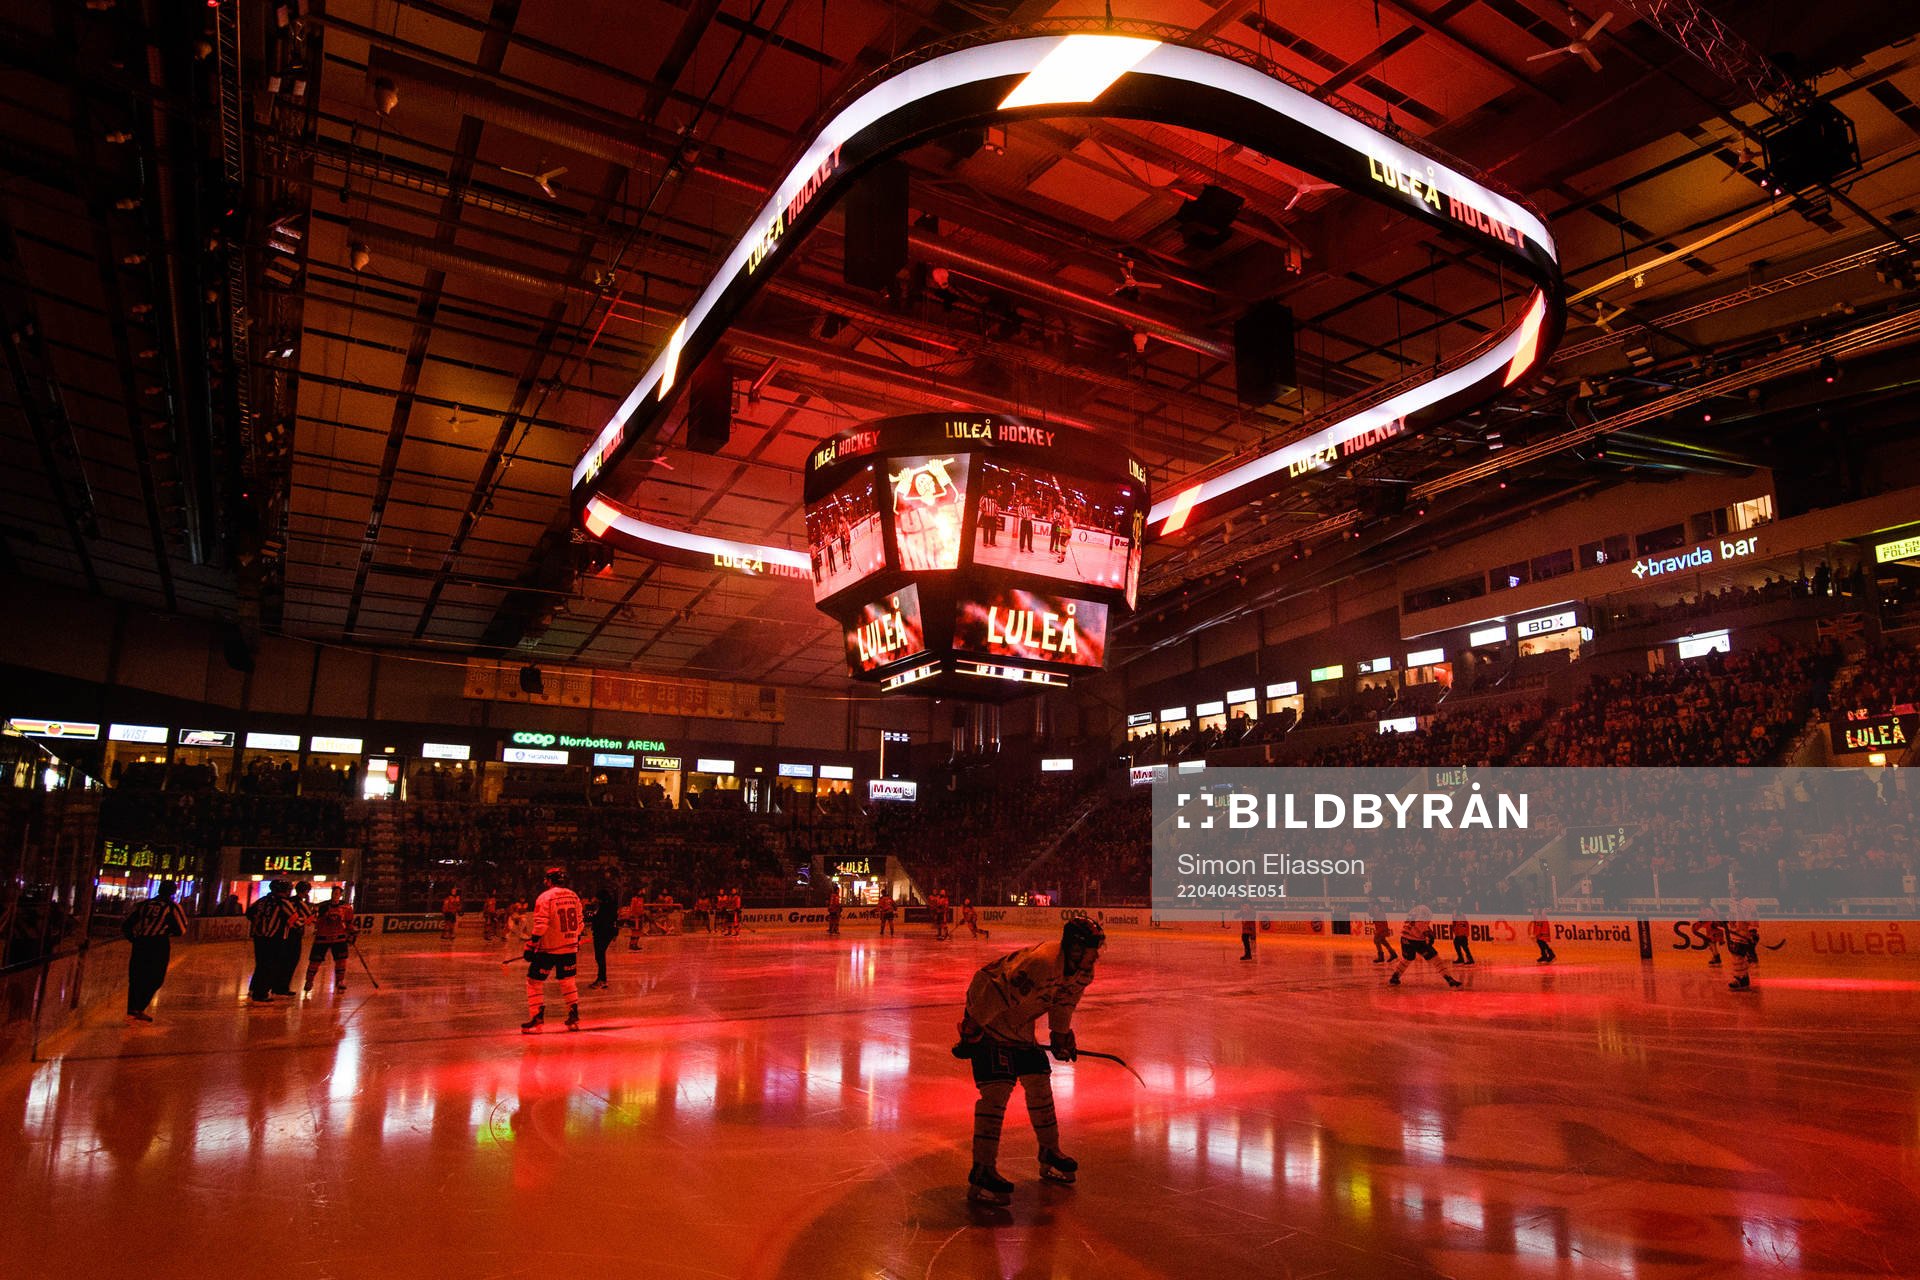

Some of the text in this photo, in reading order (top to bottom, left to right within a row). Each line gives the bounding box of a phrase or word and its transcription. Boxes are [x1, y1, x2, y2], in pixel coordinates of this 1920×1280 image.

[747, 144, 843, 276] LULEÅ HOCKEY
[1368, 152, 1527, 248] LULEÅ HOCKEY
[945, 419, 1055, 447] LULEÅ HOCKEY
[814, 430, 880, 471] LULEÅ HOCKEY
[1289, 415, 1408, 478] LULEÅ HOCKEY
[714, 549, 763, 573] LULEÅ
[1648, 536, 1758, 576] bravida bar
[857, 597, 907, 663] LULEÅ
[988, 603, 1078, 654] LULEÅ
[1528, 617, 1564, 633] BDX
[513, 733, 666, 752] coop Norrbotten ARENA
[1845, 717, 1907, 749] LULEÅ
[645, 757, 679, 769] TITAN
[264, 852, 313, 872] LULEÅ
[387, 917, 448, 931] Derome
[557, 908, 578, 933] 18
[1471, 924, 1495, 942] BIL
[1555, 924, 1632, 943] Polarbröd
